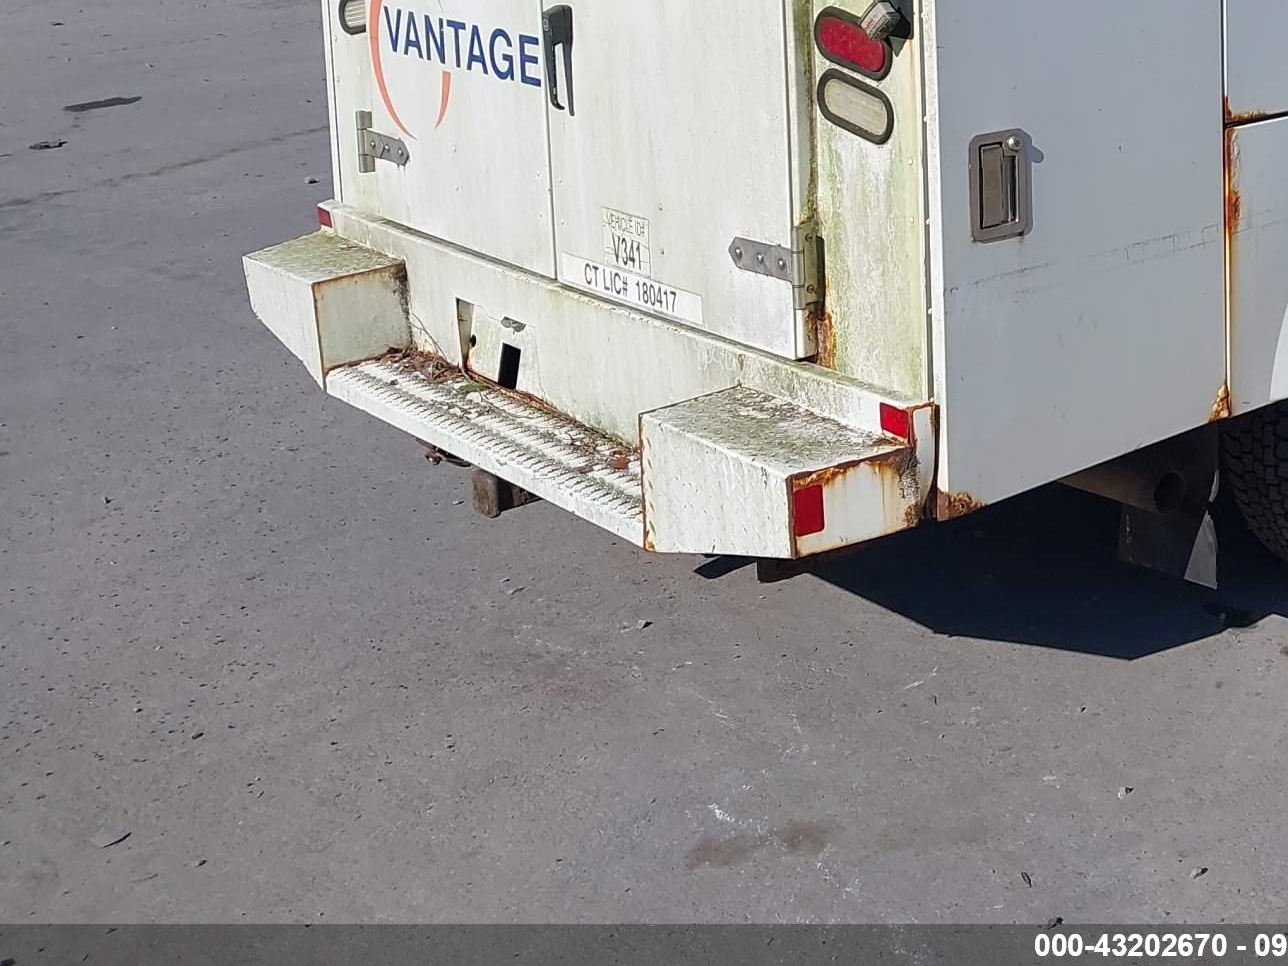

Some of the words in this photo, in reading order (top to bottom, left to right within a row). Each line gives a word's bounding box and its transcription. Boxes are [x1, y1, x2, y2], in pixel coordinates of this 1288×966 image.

[383, 5, 542, 87] VANTAGE
[611, 233, 641, 270] V341
[584, 263, 600, 286] CT
[603, 269, 628, 297] LIC#
[635, 280, 677, 313] 180417
